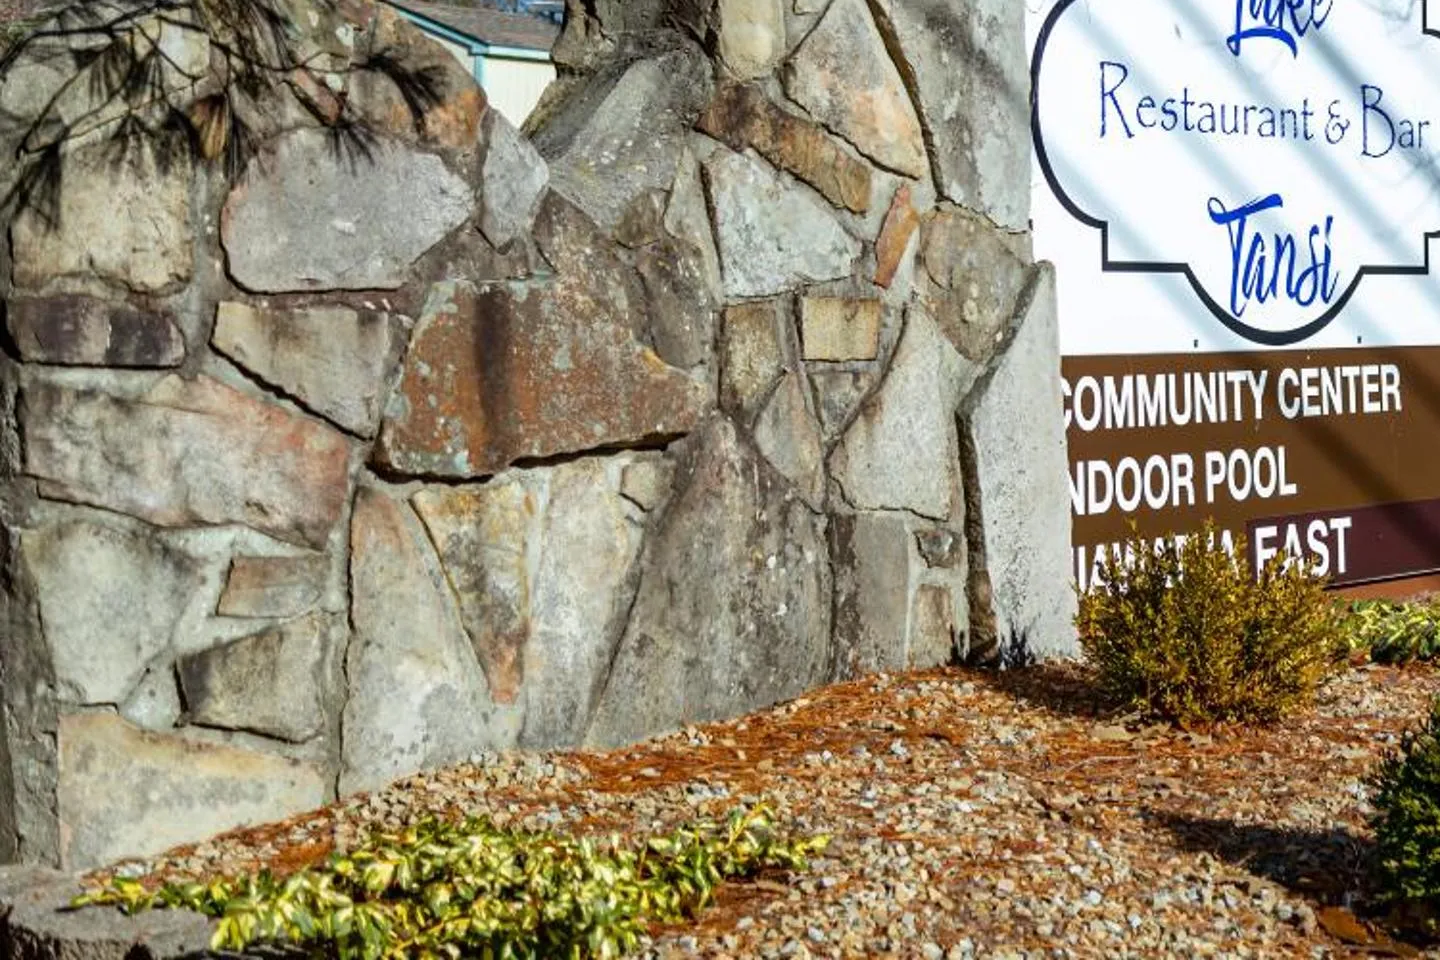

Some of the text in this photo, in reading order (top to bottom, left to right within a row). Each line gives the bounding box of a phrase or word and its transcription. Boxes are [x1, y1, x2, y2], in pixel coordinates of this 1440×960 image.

[1099, 61, 1430, 158] Restaurant & Bar
[1207, 193, 1339, 317] Tansi
[1278, 364, 1402, 419] CENTER
[1067, 446, 1297, 516] NDOOR POOL
